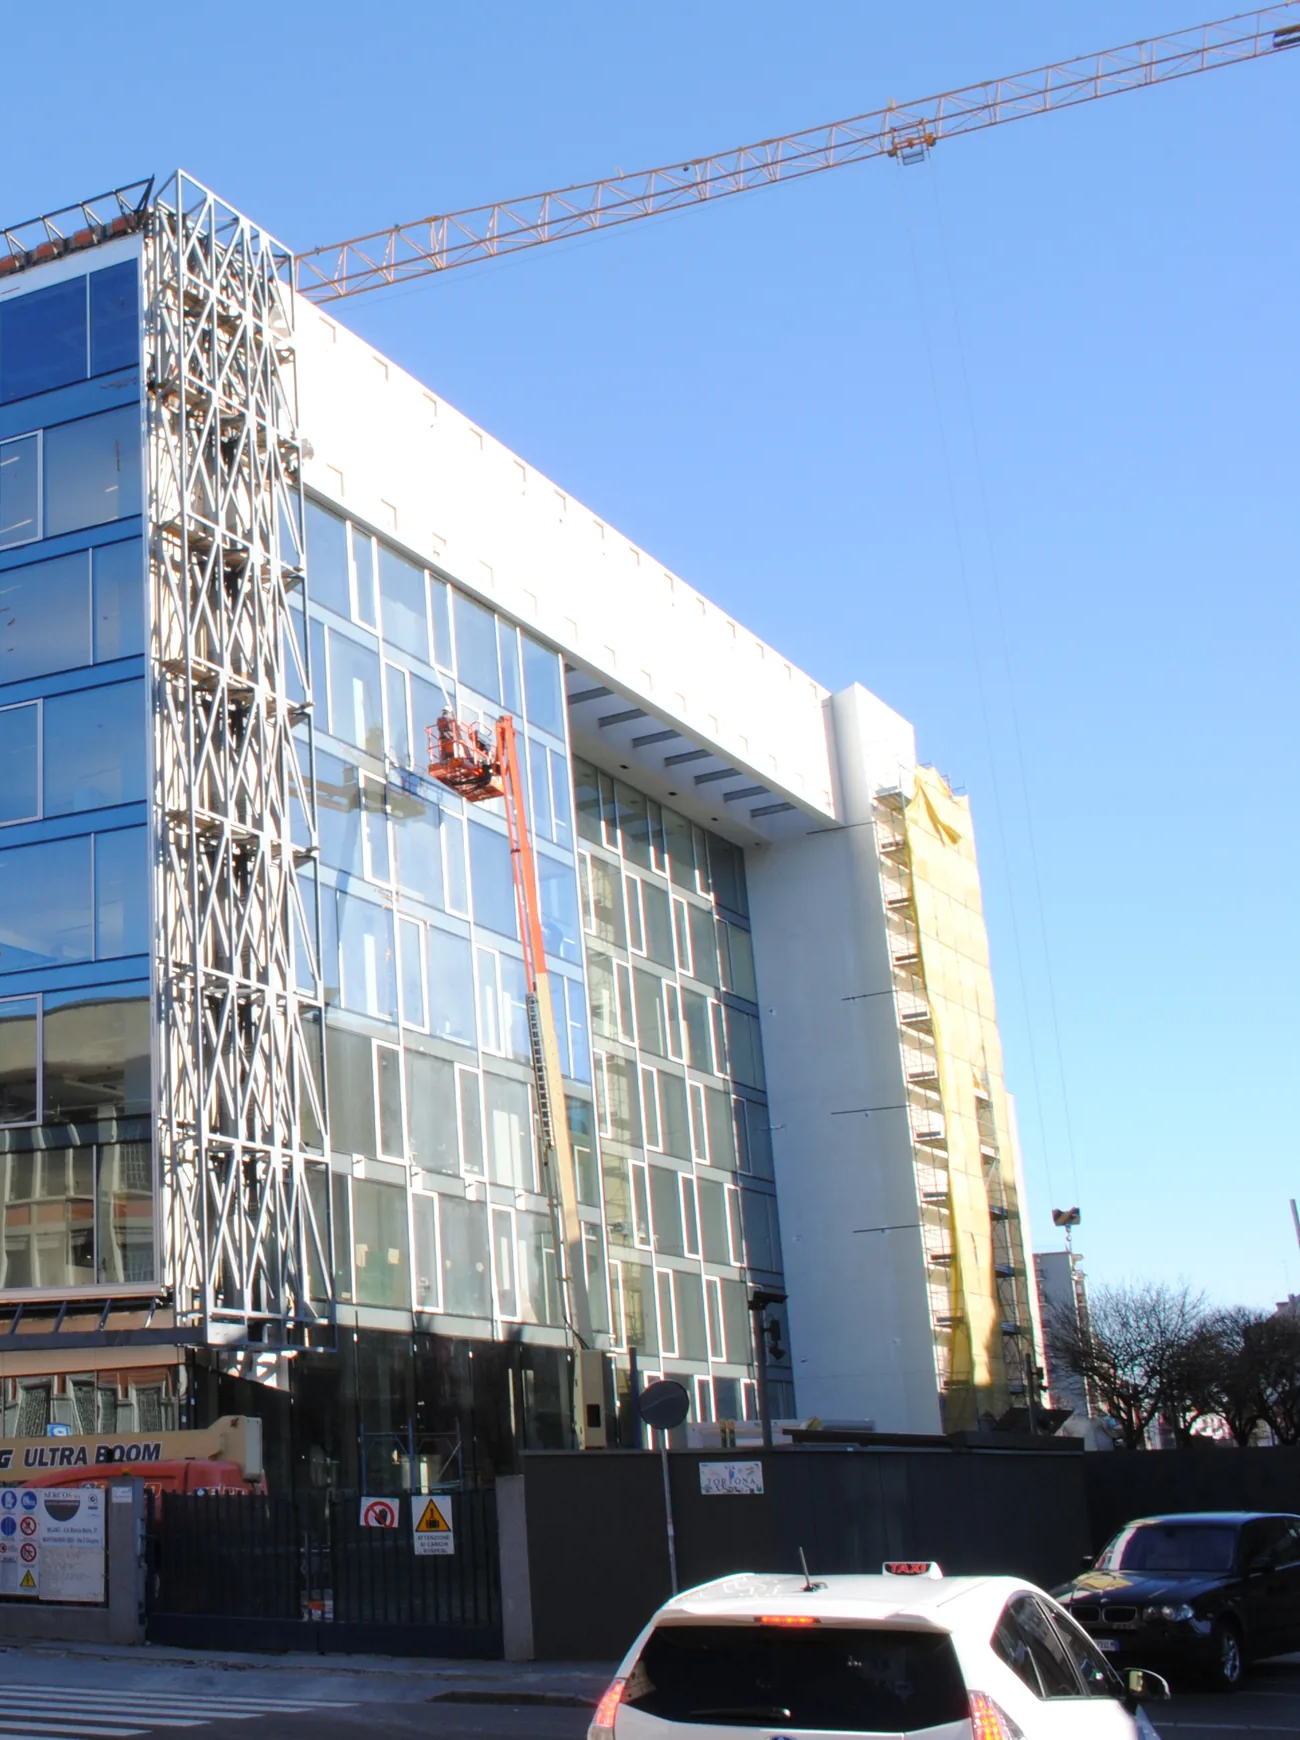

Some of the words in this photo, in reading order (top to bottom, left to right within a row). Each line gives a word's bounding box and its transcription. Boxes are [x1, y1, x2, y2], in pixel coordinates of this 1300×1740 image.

[23, 1445, 88, 1467] ULTRA
[95, 1443, 161, 1464] BOOM
[707, 1477, 757, 1485] TORTONA
[891, 1563, 927, 1574] TAXI
